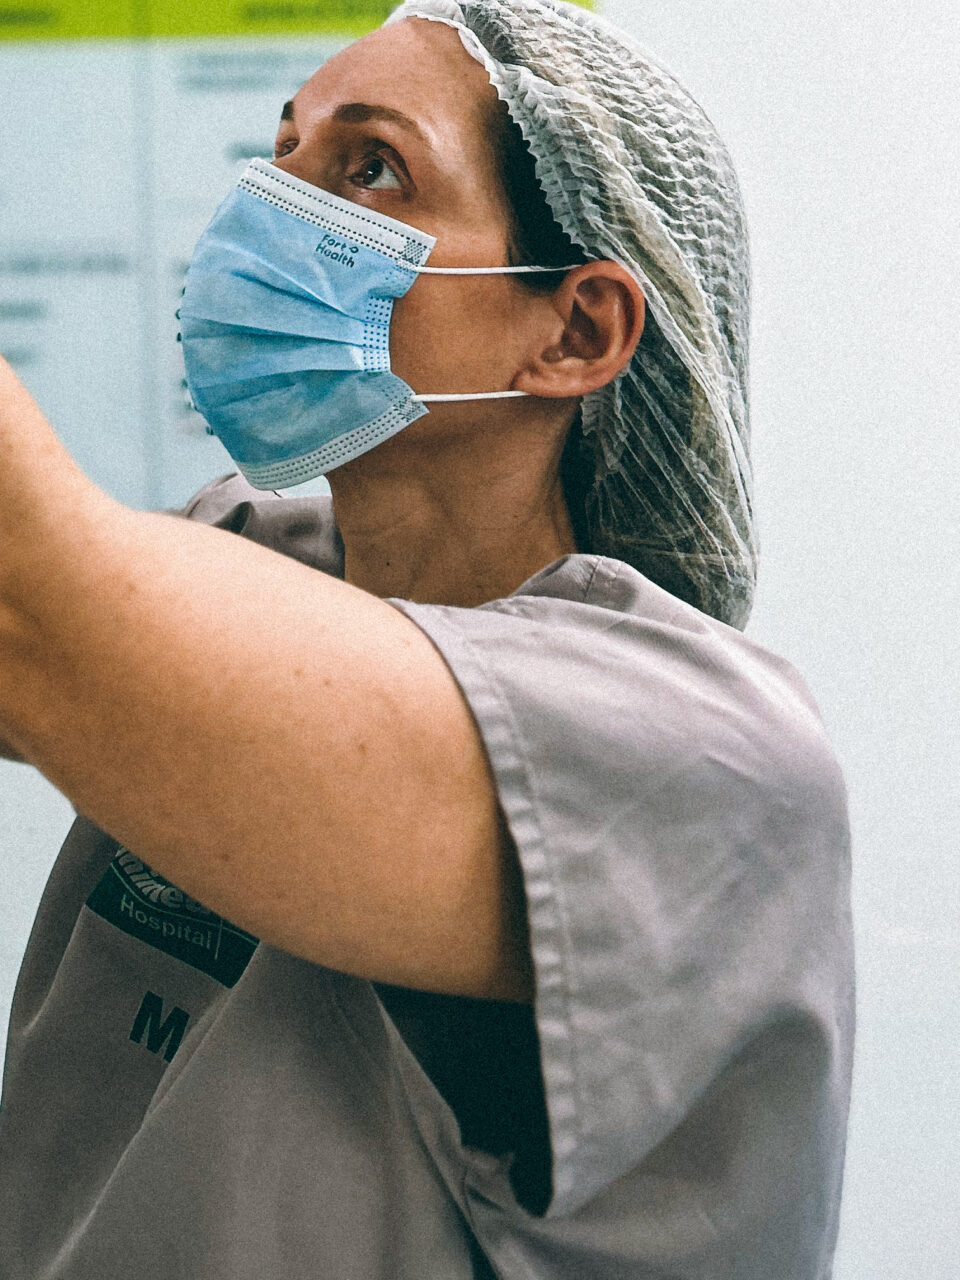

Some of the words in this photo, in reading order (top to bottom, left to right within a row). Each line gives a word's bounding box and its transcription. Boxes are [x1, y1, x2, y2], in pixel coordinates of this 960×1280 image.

[315, 243, 355, 268] Health
[120, 894, 213, 950] Hospital
[129, 990, 191, 1064] M
